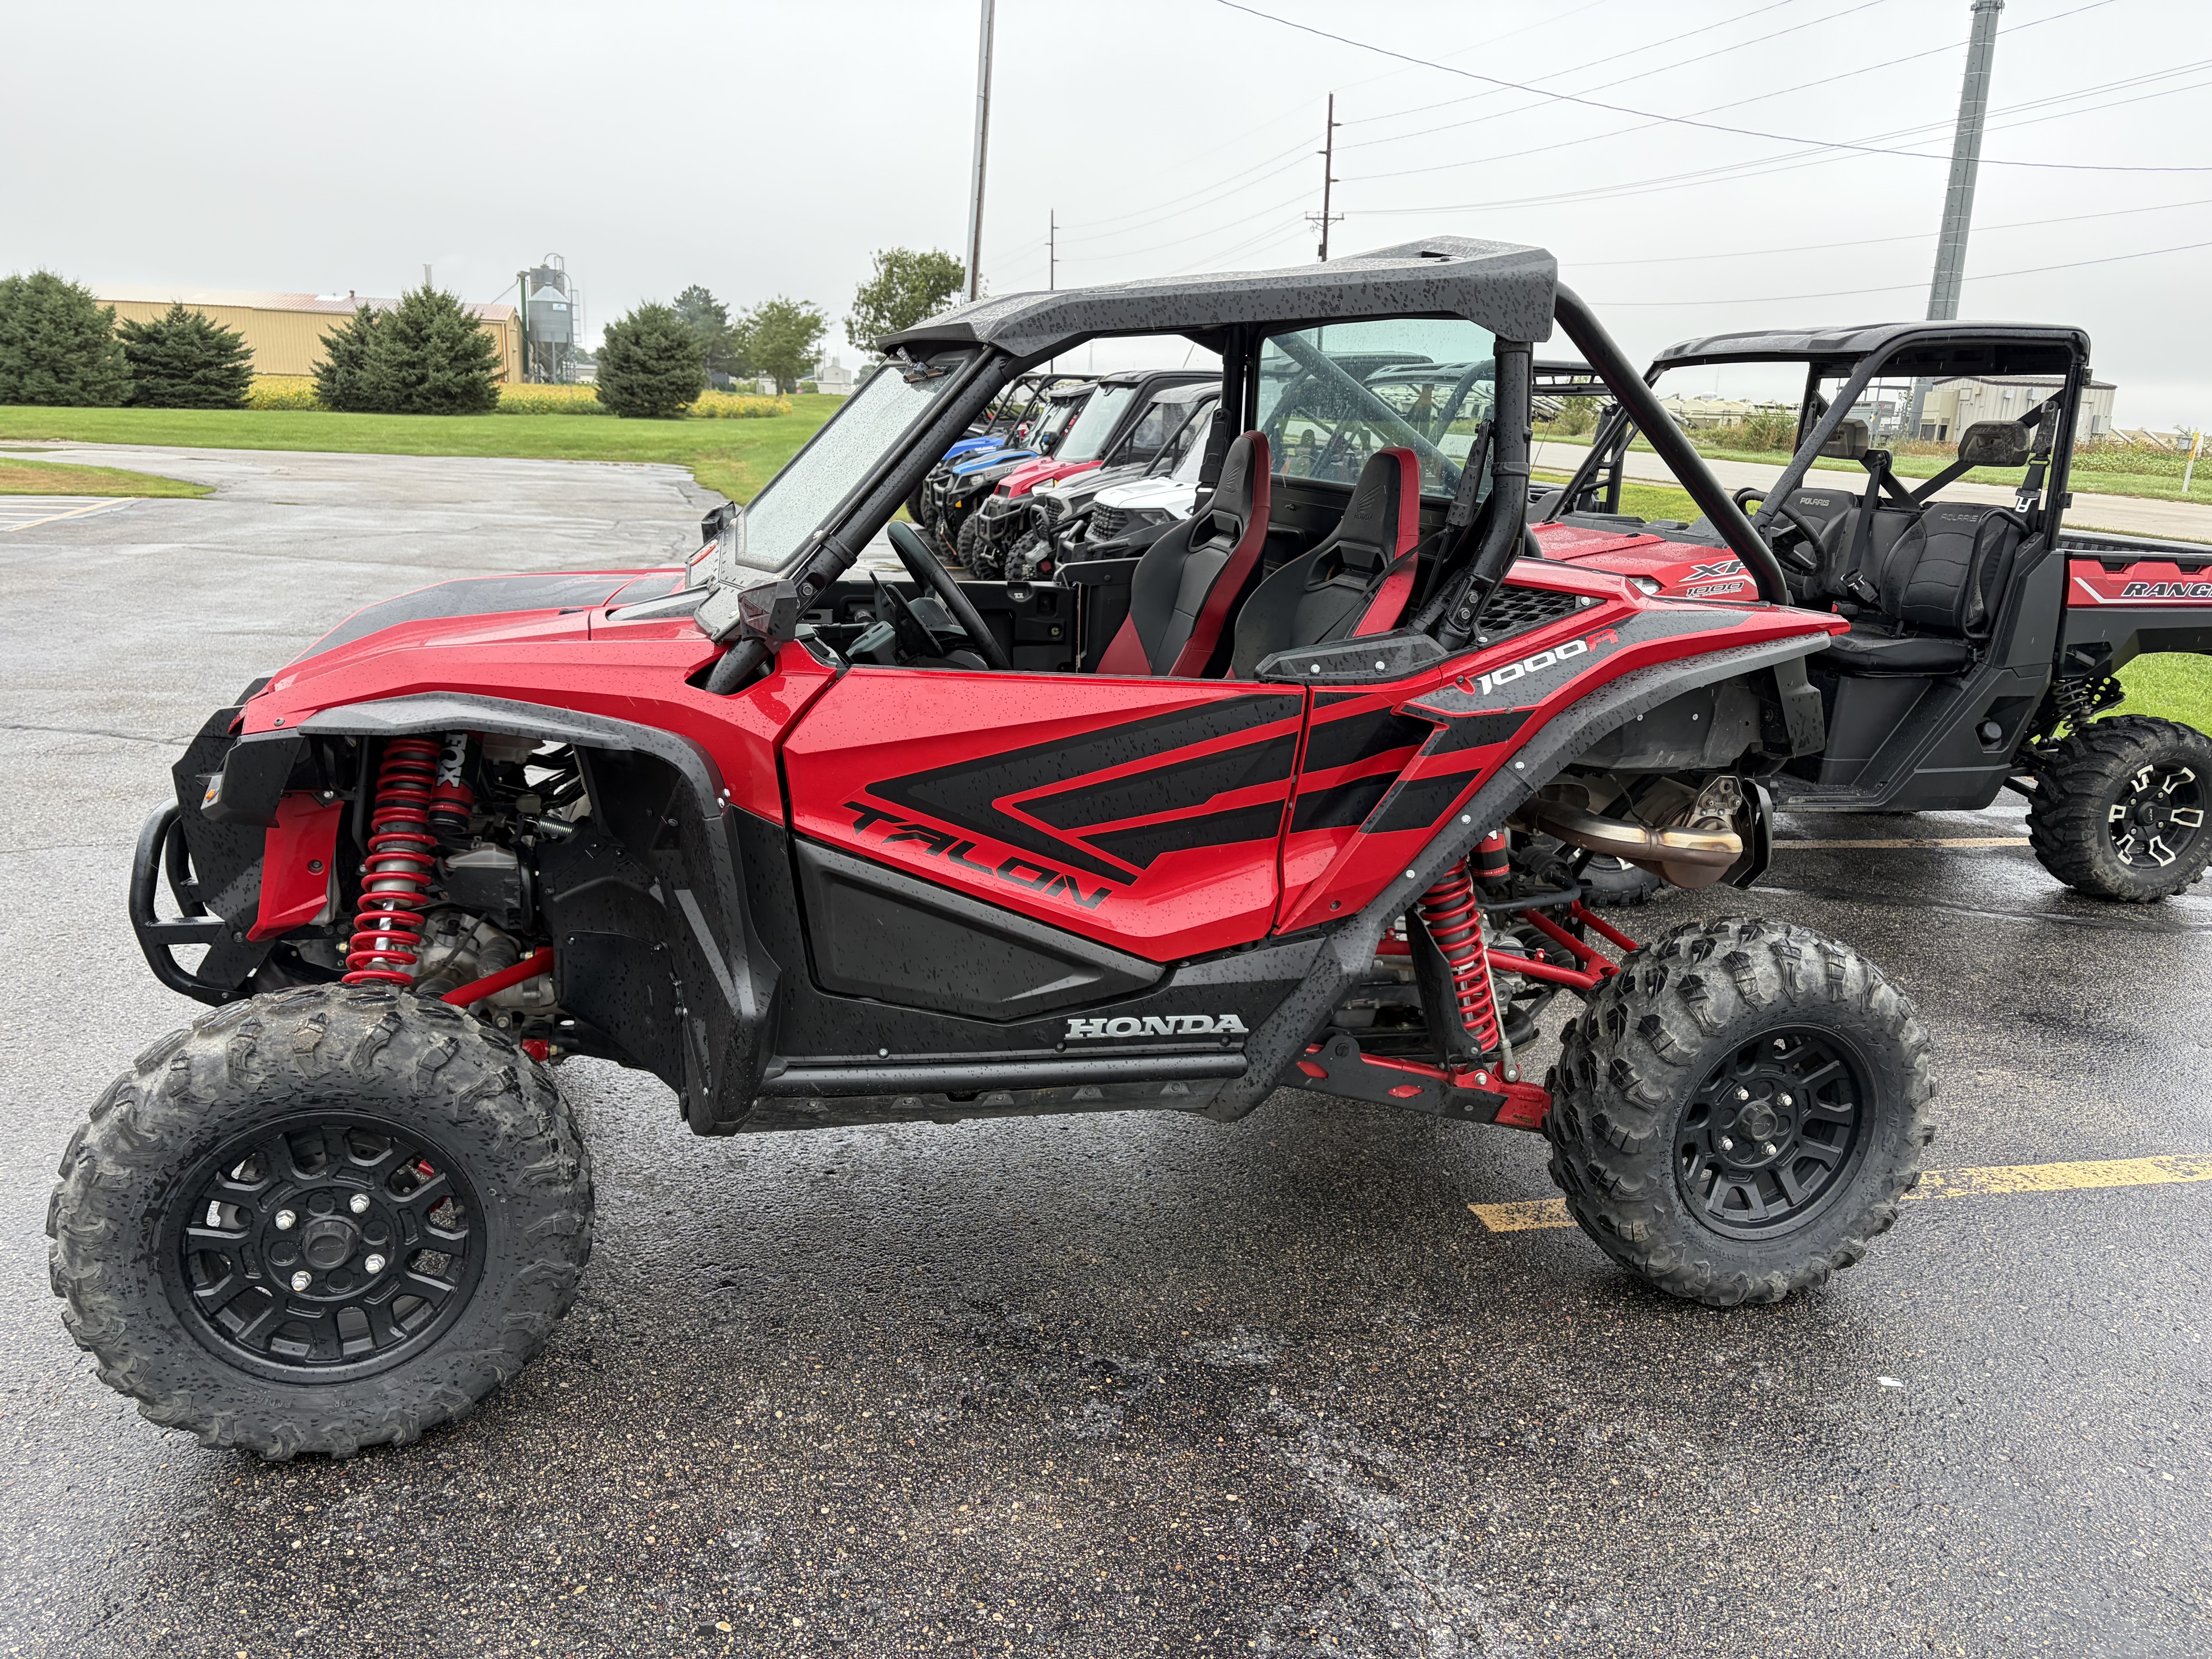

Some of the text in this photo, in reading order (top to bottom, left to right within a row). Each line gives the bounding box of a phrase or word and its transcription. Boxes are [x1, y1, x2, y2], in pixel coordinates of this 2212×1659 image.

[1800, 497, 1830, 507] POLARIS
[1940, 513, 1979, 522] POLARIS
[1686, 581, 1745, 596] 1000
[2121, 582, 2212, 598] RANG
[1477, 628, 1620, 696] 1000R
[436, 733, 468, 788] FOX
[842, 801, 1113, 910] TALON
[1065, 1014, 1249, 1039] HONDA
